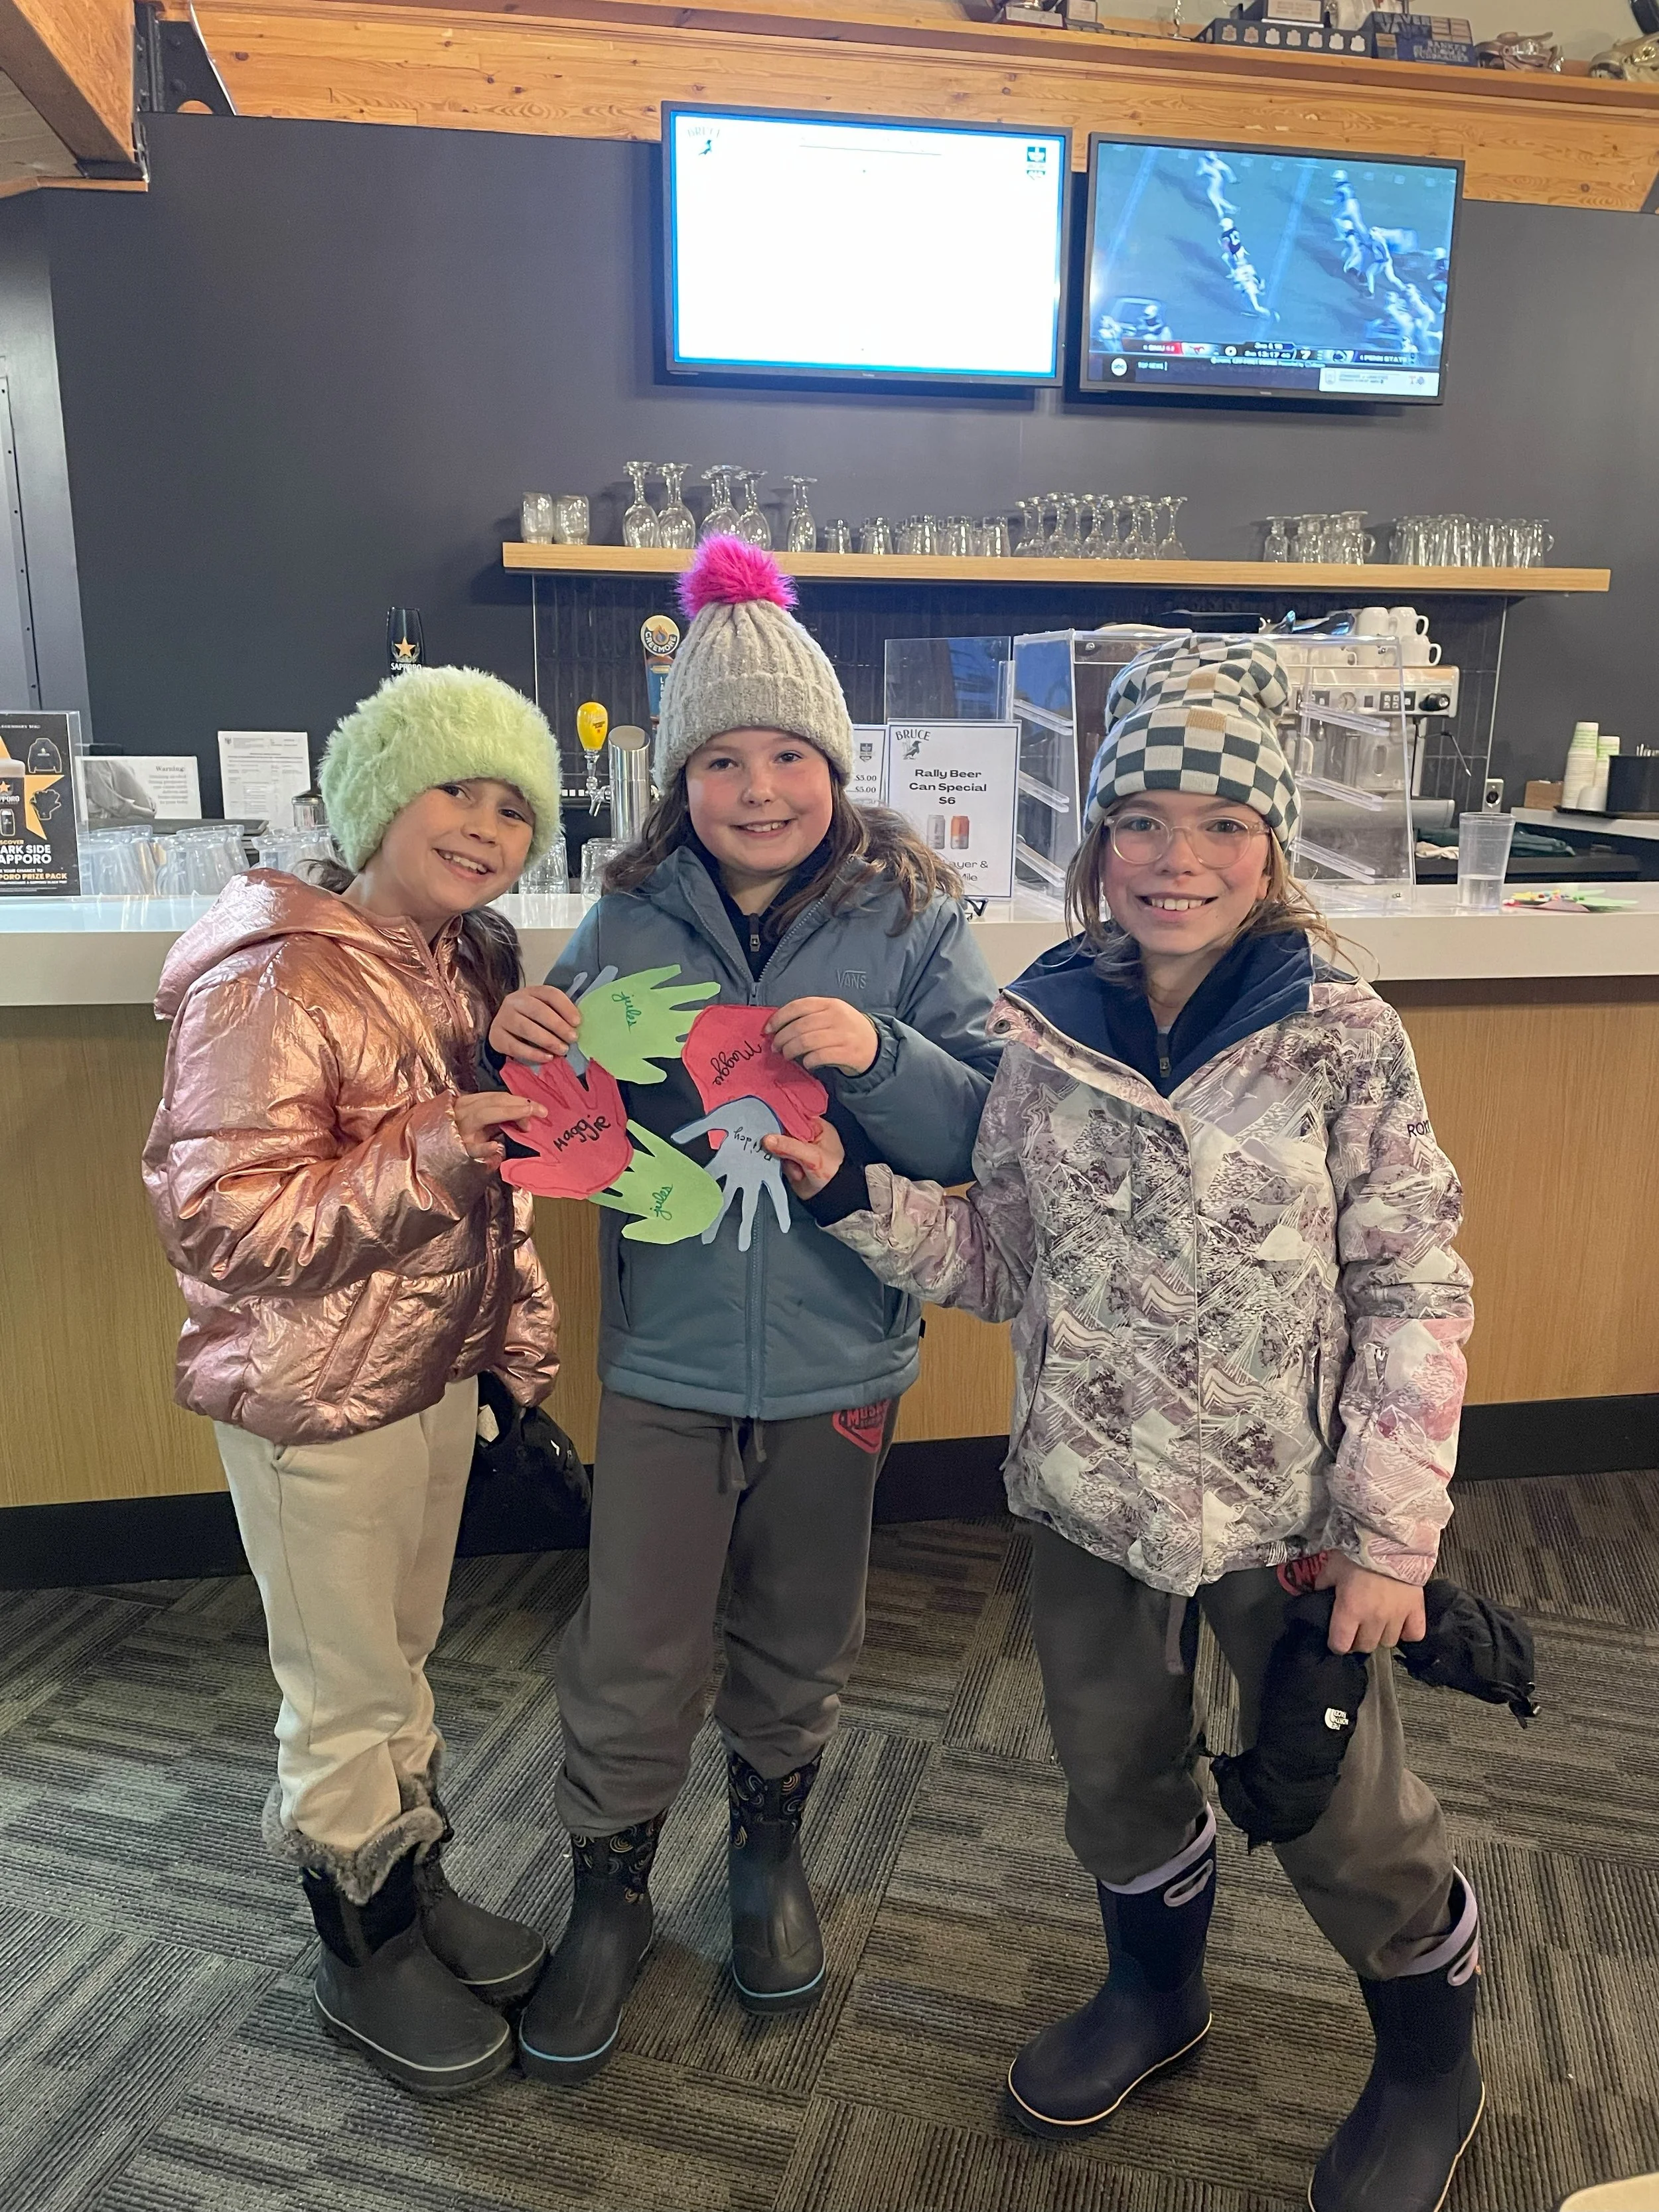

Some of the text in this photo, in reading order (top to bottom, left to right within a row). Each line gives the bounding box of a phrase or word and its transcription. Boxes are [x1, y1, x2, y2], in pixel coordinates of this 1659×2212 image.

[1301, 350, 1311, 360] 7
[645, 631, 676, 652] CREEMORE
[896, 729, 930, 741] BRUCE
[915, 769, 947, 779] Rally
[938, 783, 987, 792] Special
[26, 845, 51, 854] SIDE
[836, 969, 867, 990] VANS
